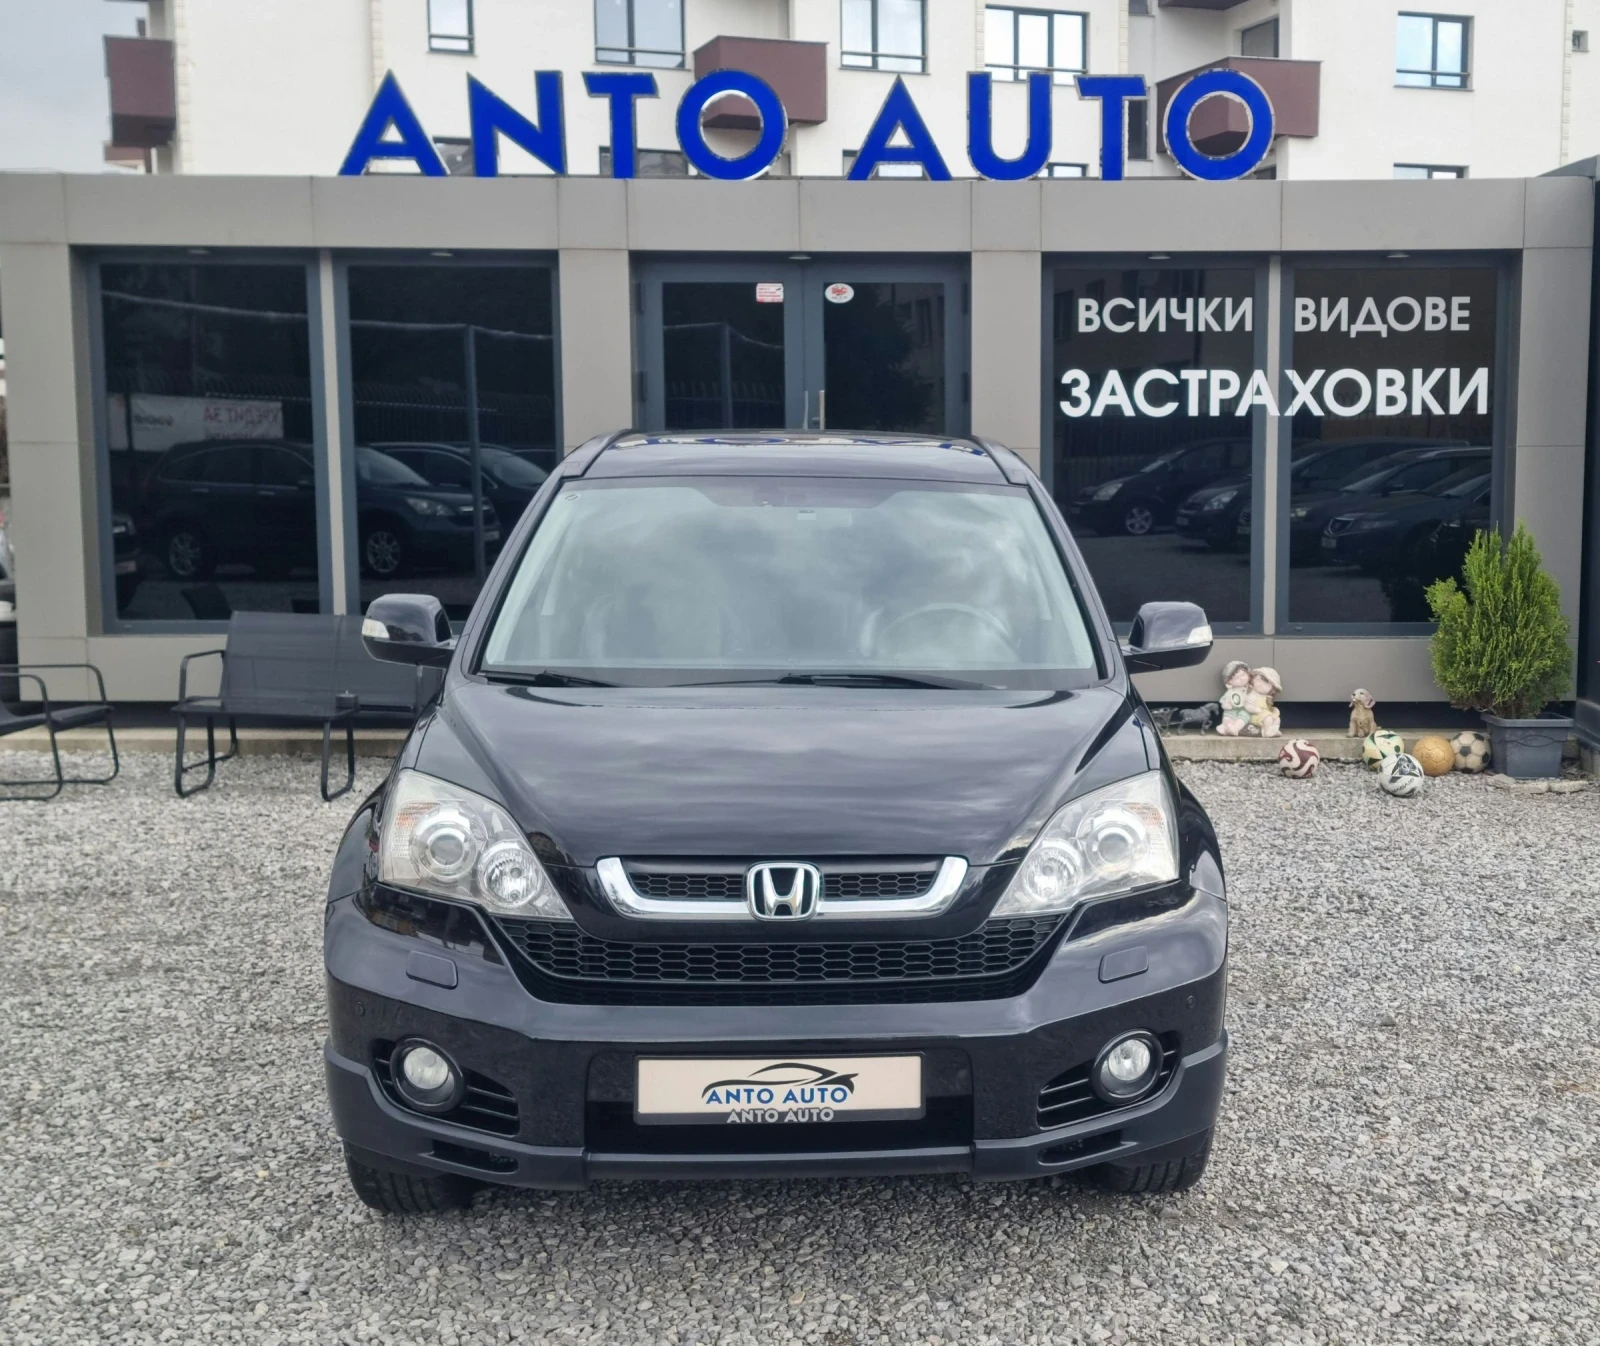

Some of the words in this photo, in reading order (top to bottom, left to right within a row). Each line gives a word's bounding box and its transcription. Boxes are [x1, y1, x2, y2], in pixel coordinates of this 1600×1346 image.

[339, 69, 788, 182] ANTO
[847, 70, 1277, 183] AUTO
[1077, 296, 1254, 334] ВСИЧКИ
[1294, 295, 1472, 339] ВИДОВЕ
[1059, 367, 1490, 418] ЗАСТРАХОВКИ
[706, 1088, 774, 1104] ANTO
[782, 1087, 848, 1103] AUTO
[726, 1108, 779, 1123] ANTO
[783, 1107, 834, 1123] AUTO
